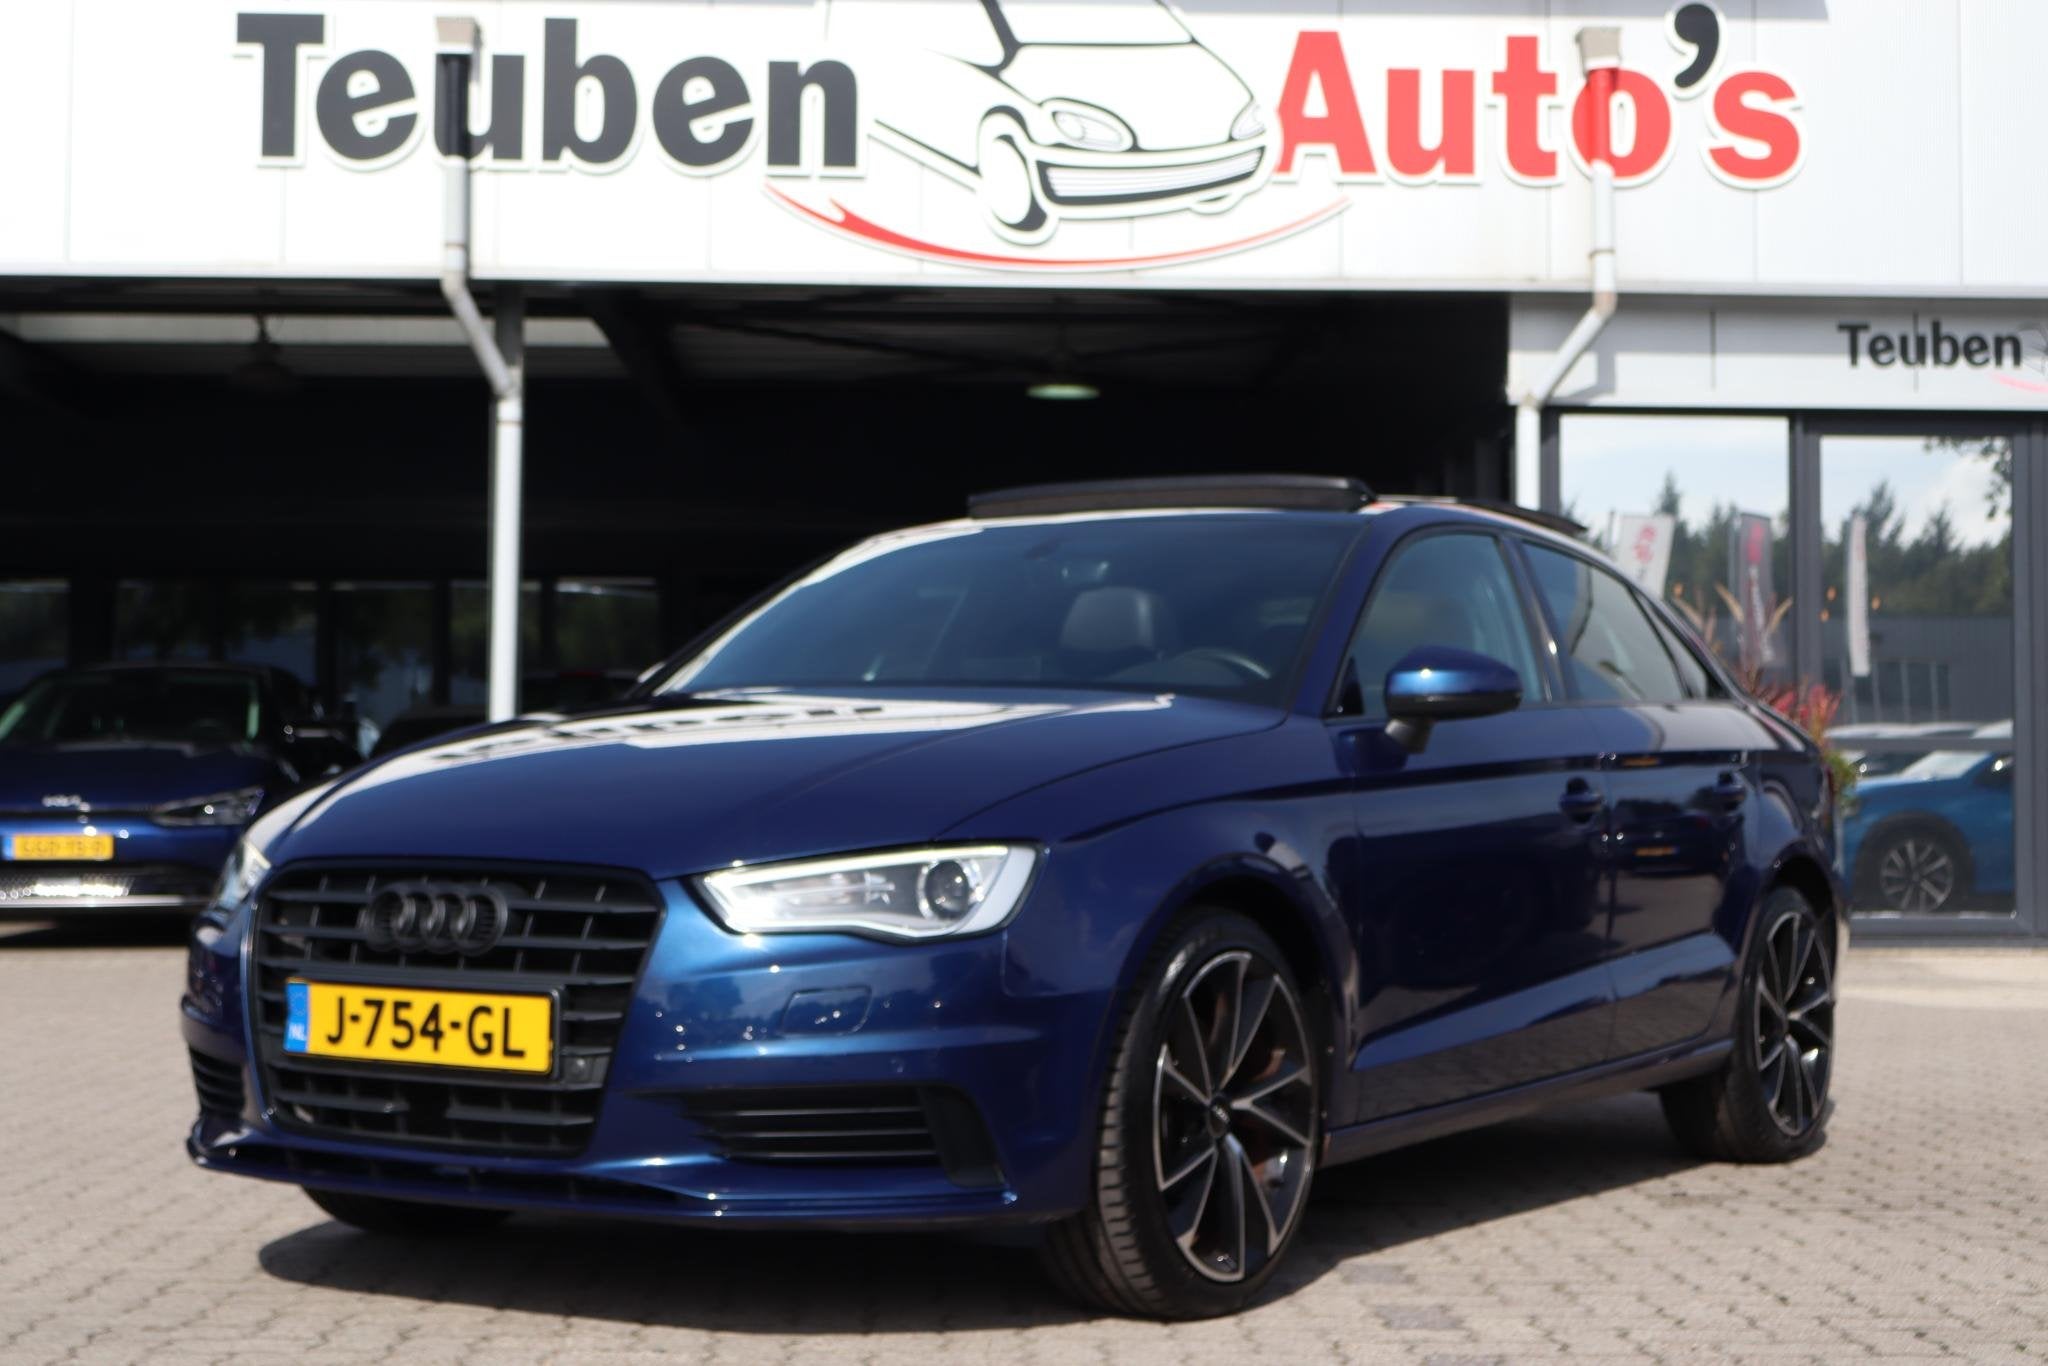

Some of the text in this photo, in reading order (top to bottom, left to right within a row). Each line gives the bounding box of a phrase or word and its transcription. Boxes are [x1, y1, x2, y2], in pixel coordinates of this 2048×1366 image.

[236, 3, 1801, 181] Teuben Auto's
[1837, 320, 2023, 368] Teuben
[327, 996, 526, 1058] J-754-GL
